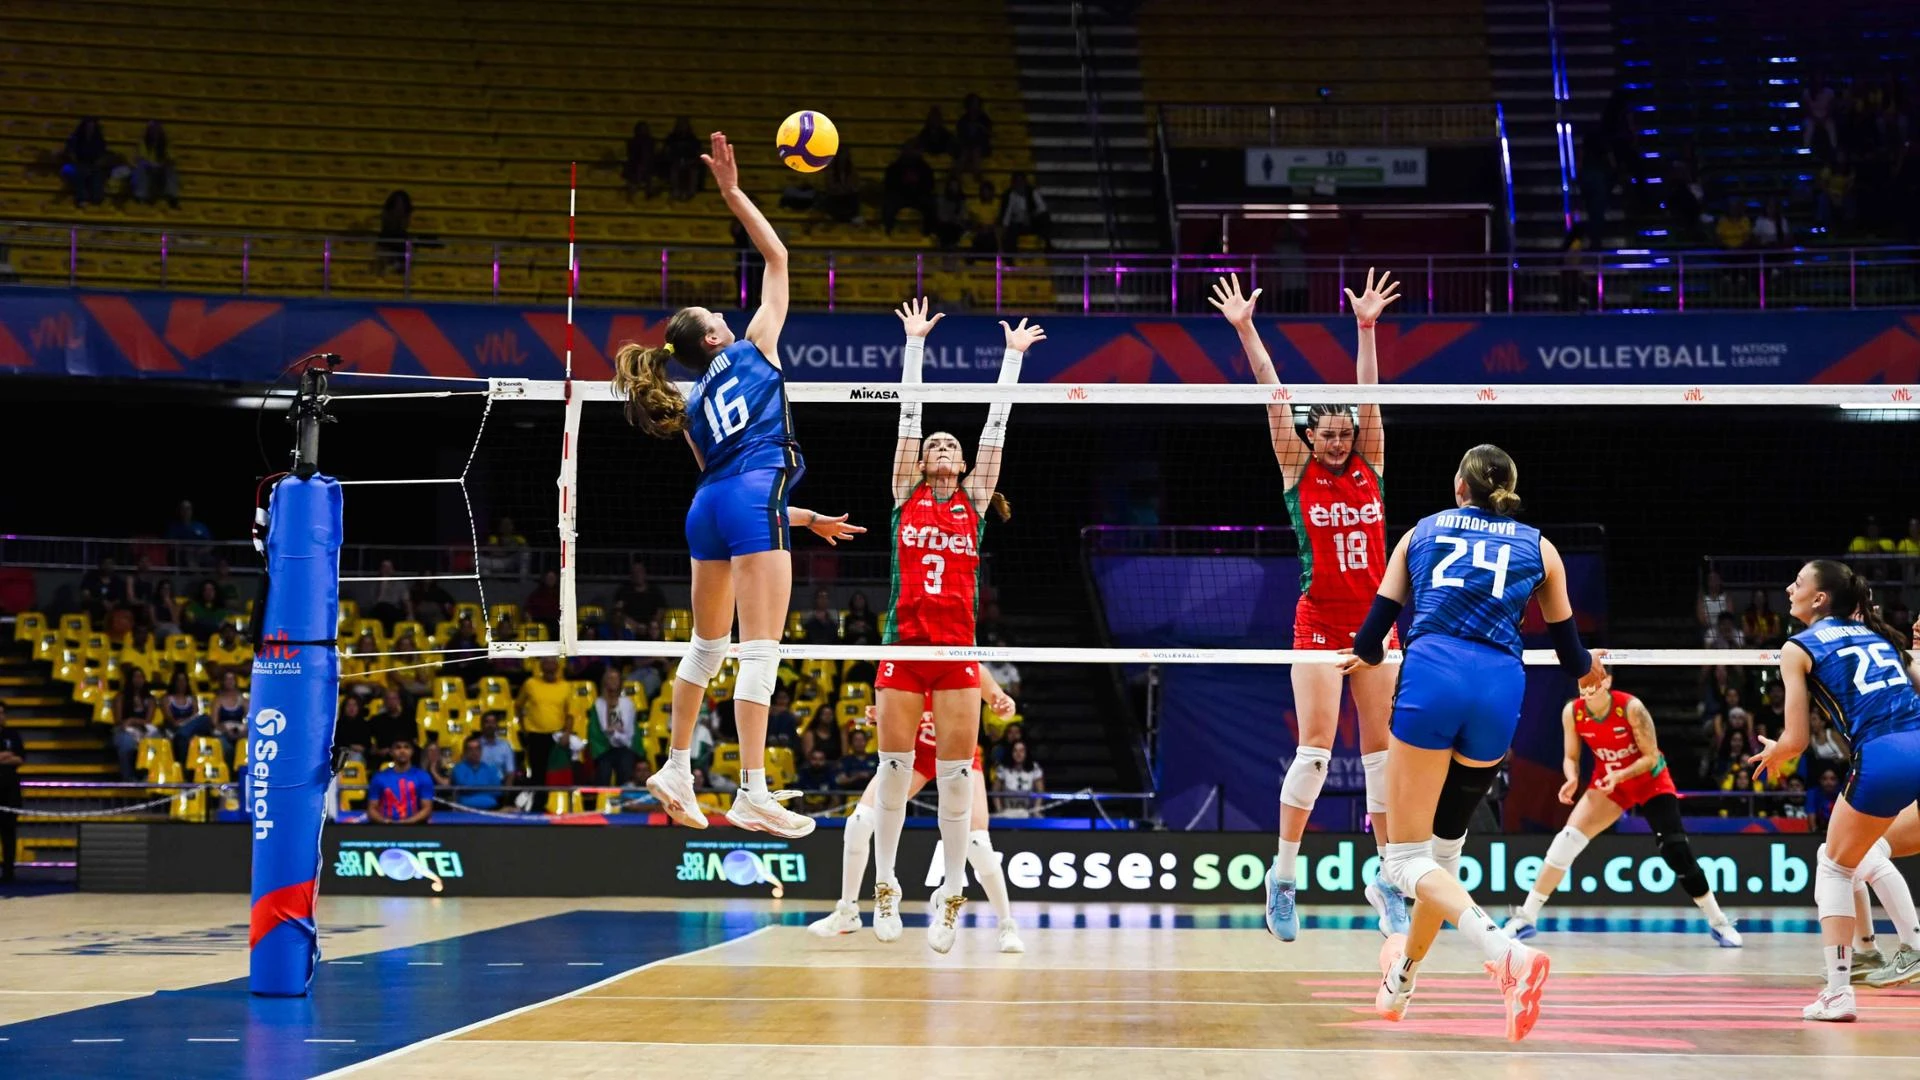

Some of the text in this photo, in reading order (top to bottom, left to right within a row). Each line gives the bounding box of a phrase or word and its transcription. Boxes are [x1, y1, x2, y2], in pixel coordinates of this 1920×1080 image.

[1326, 151, 1347, 166] 10
[784, 343, 970, 369] VOLLEYALL
[1537, 345, 1727, 370] VOLLEYBALL
[1731, 344, 1787, 354] NATIONS
[1731, 356, 1780, 368] LEAGUE
[1067, 386, 1089, 401] VNL
[1271, 386, 1293, 401] VNL
[1477, 386, 1498, 401] VNL
[1684, 387, 1705, 401] VNL
[1891, 387, 1913, 401] VNL
[703, 375, 750, 445] 16
[1309, 497, 1383, 527] efbet
[1435, 514, 1516, 536] ANTROPOVA
[1333, 530, 1368, 573] 18
[921, 553, 946, 595] 3
[1431, 535, 1511, 600] 24
[1312, 632, 1326, 645] 18
[884, 661, 895, 678] 3
[1836, 642, 1908, 696] 25
[254, 739, 279, 841] Senoh
